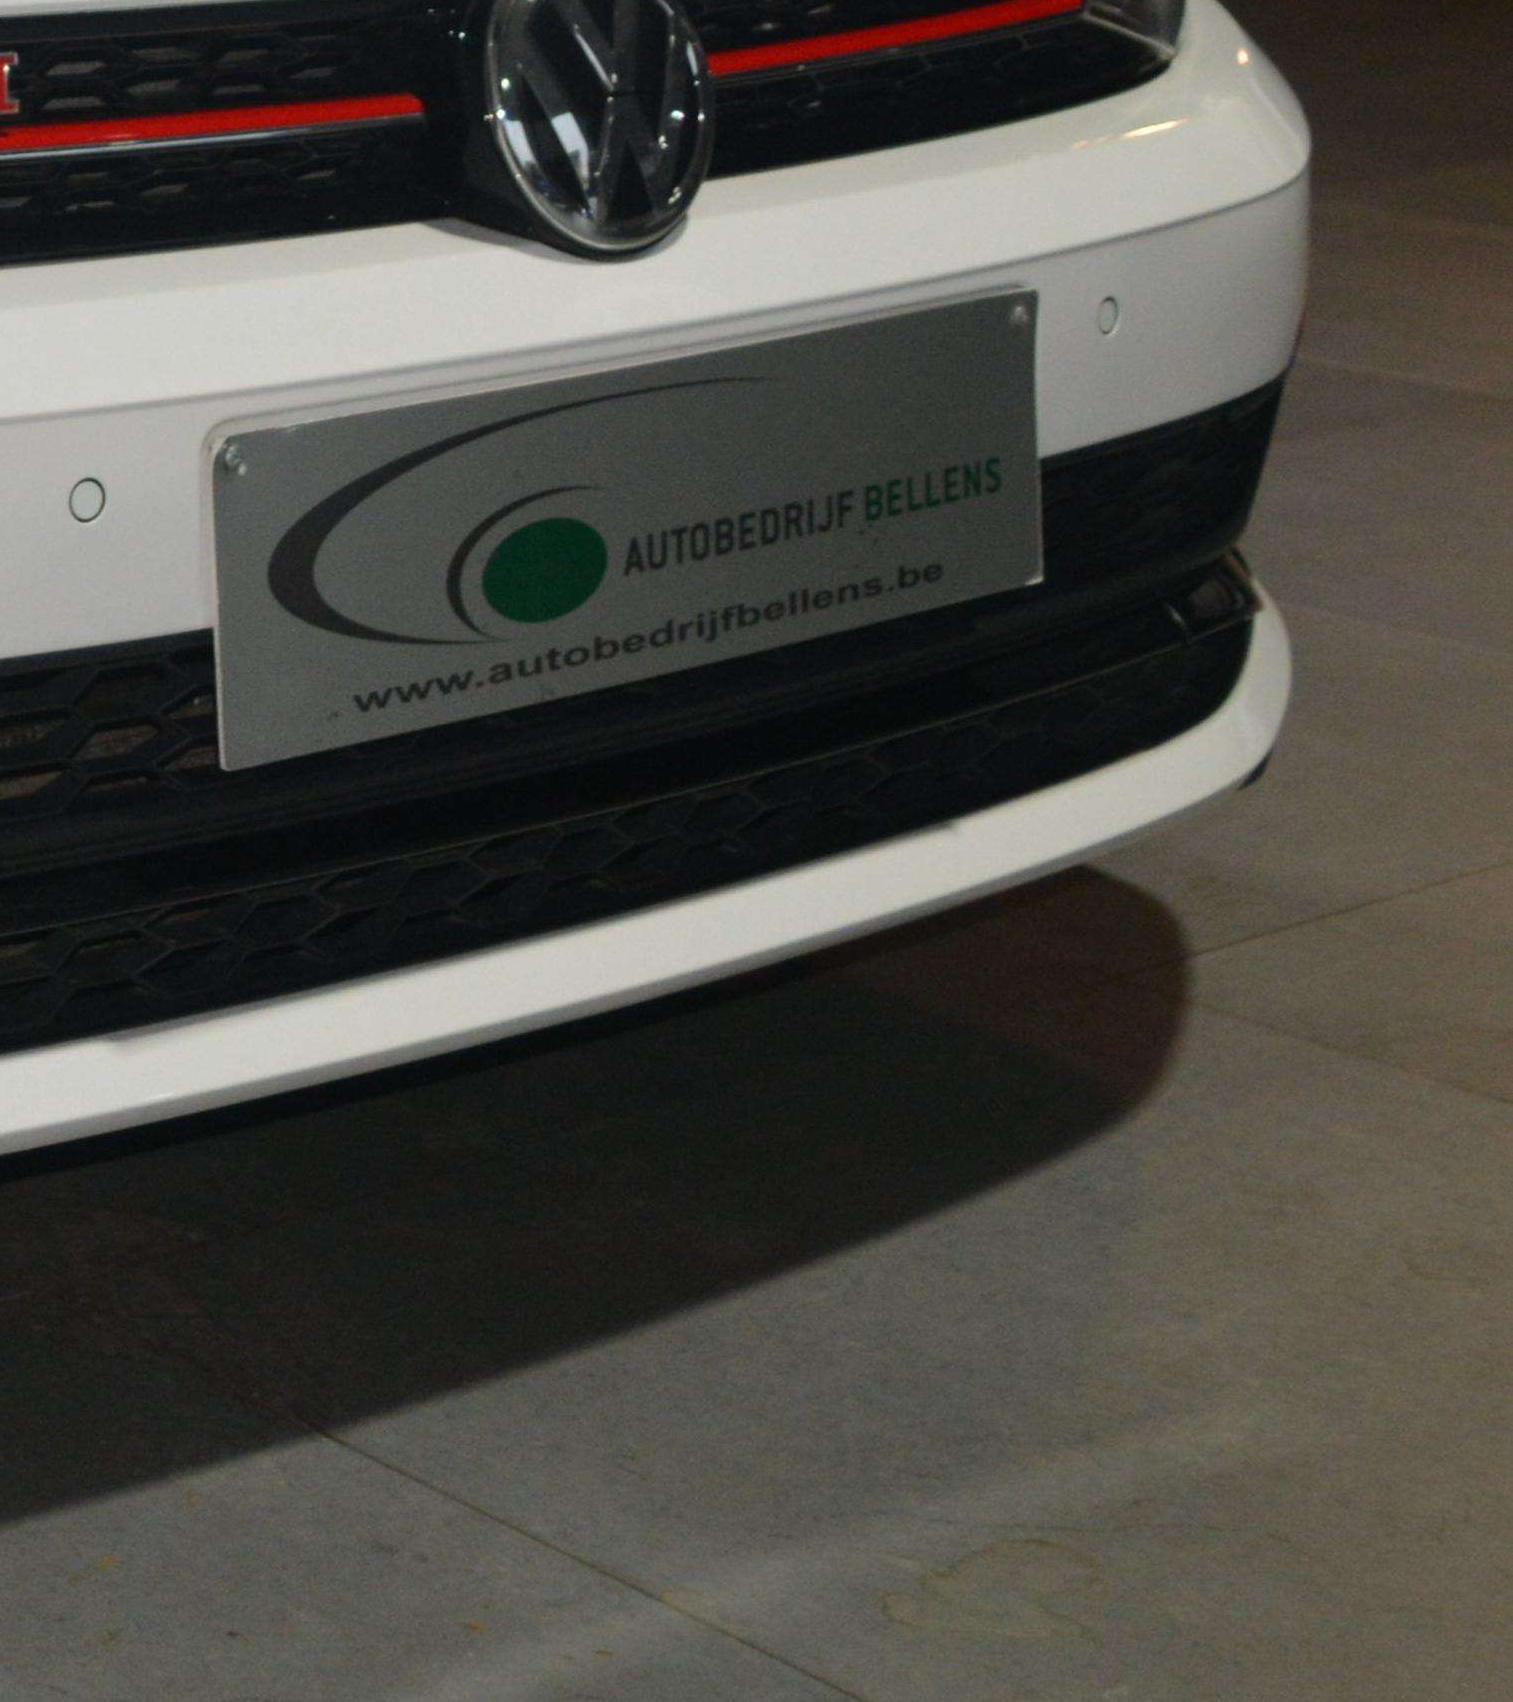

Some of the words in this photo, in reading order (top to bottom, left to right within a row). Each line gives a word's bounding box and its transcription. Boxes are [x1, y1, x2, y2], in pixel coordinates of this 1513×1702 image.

[623, 488, 855, 577] AUTOBEDRIJF
[864, 457, 1003, 523] BELLENS
[352, 558, 945, 715] www.autobedrijfbellens.be
